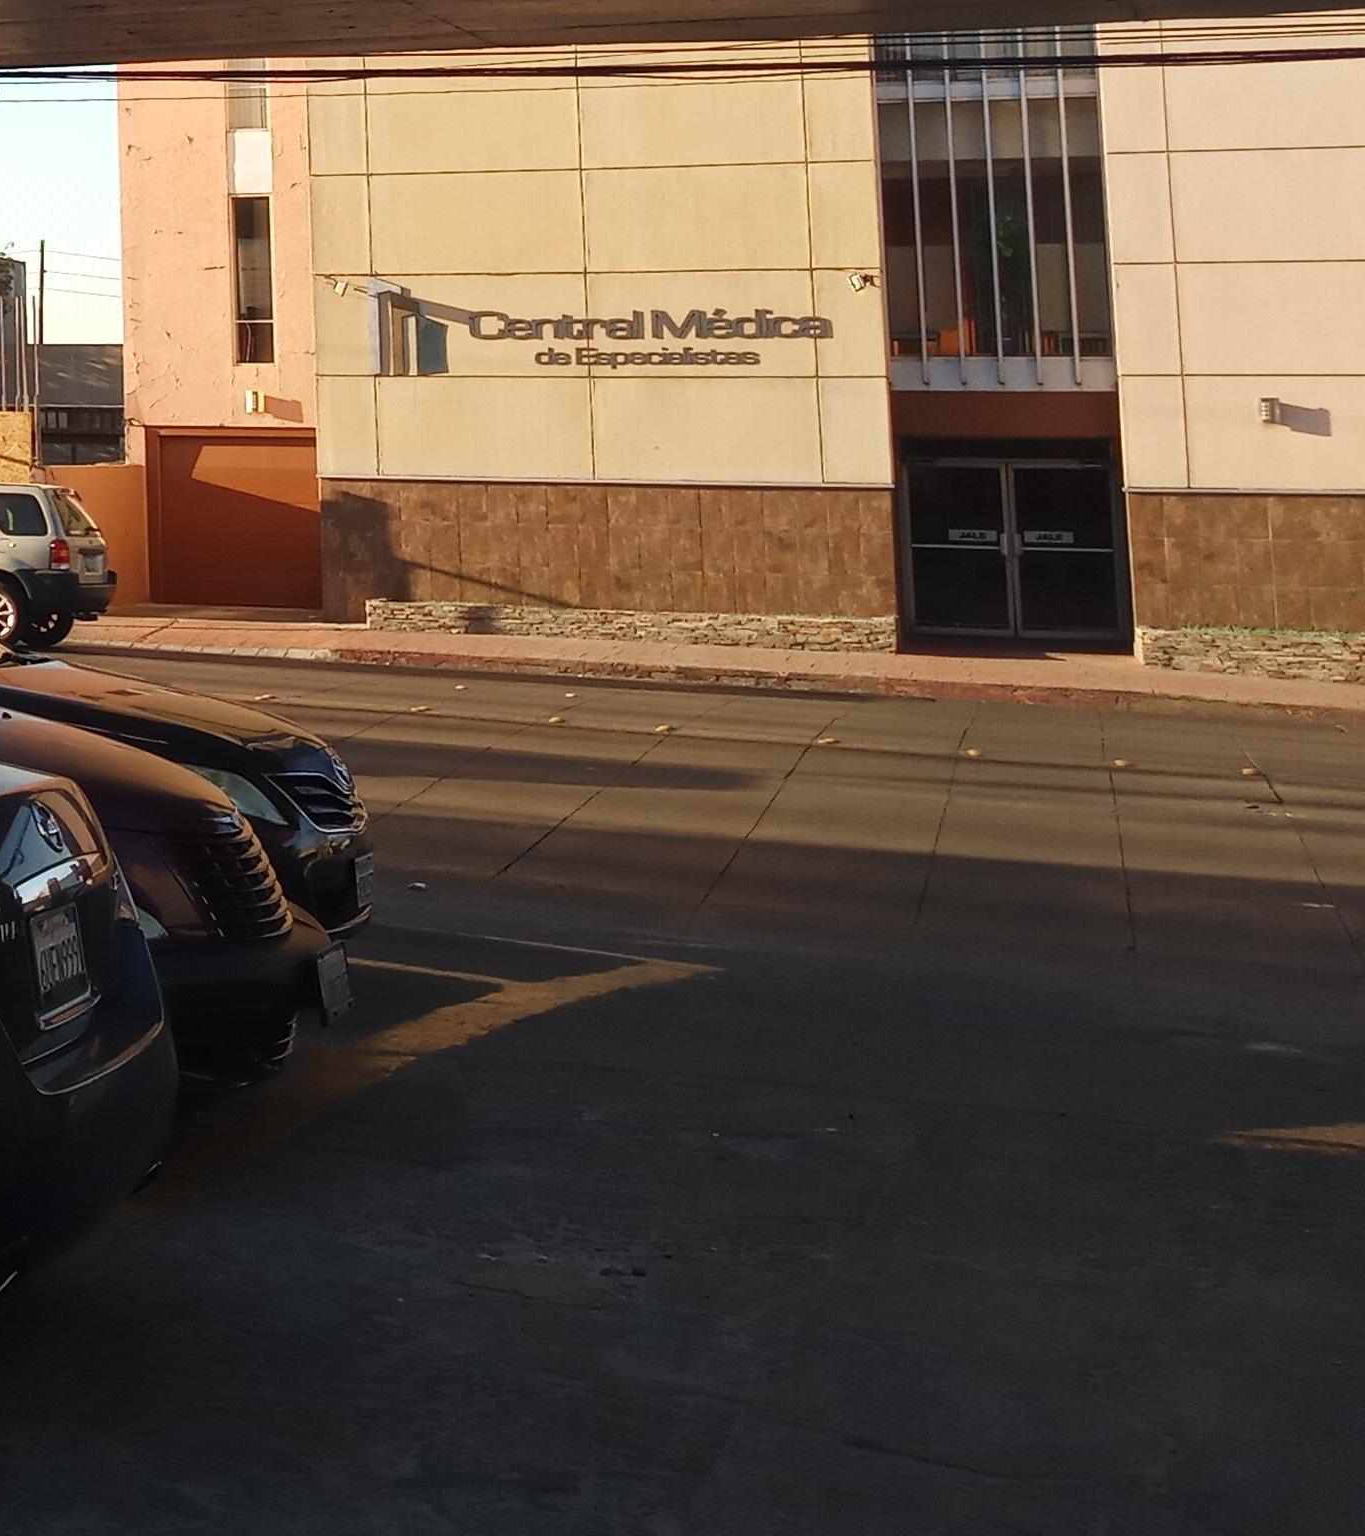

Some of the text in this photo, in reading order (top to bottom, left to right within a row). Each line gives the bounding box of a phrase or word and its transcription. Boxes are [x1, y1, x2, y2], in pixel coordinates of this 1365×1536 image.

[468, 307, 833, 341] Central Médica
[534, 347, 761, 370] de Especialistas
